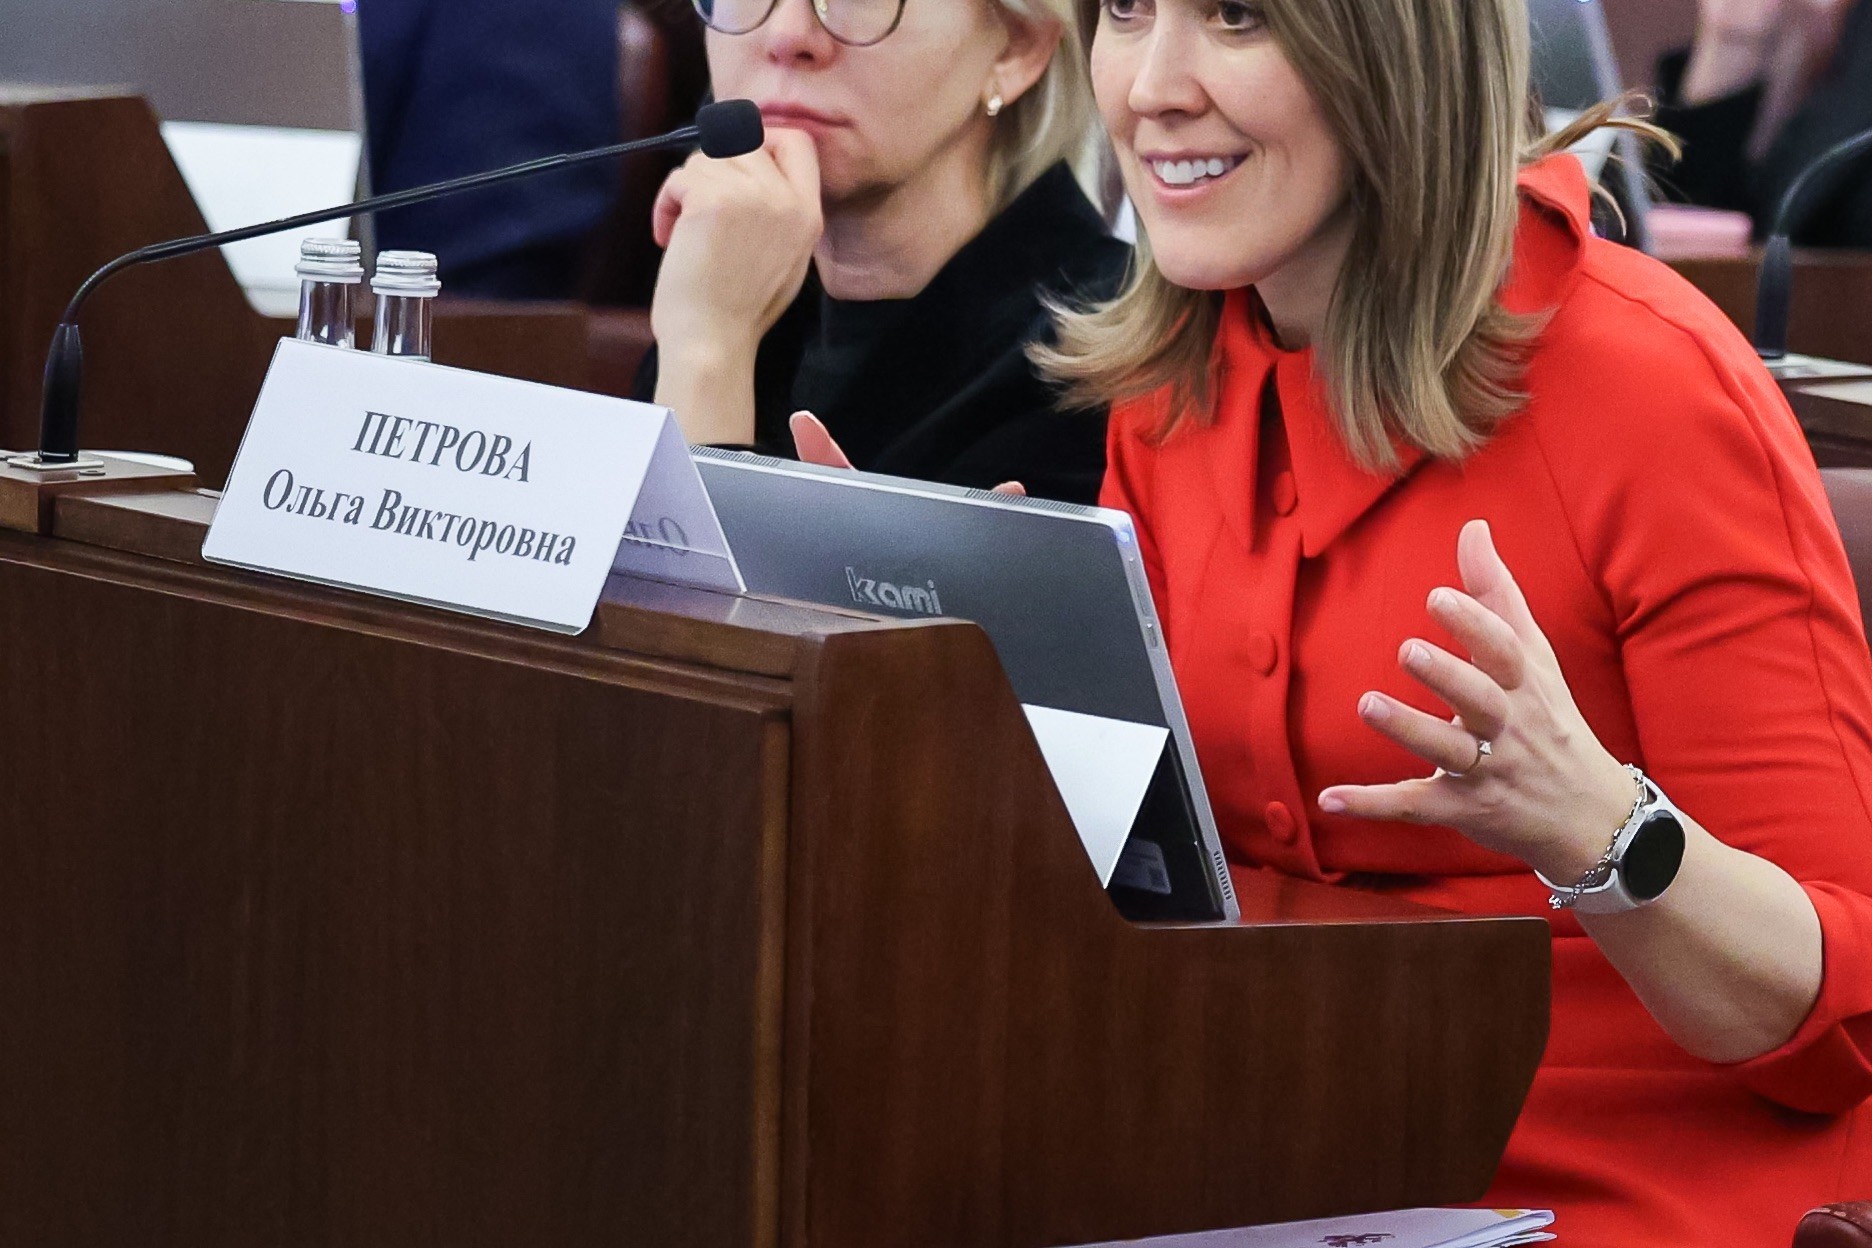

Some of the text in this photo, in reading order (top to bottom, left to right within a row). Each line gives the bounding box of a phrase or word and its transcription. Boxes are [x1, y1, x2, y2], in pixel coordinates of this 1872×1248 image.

[350, 410, 531, 483] ПЕТРОВА
[261, 468, 577, 567] Ольга Викторовна
